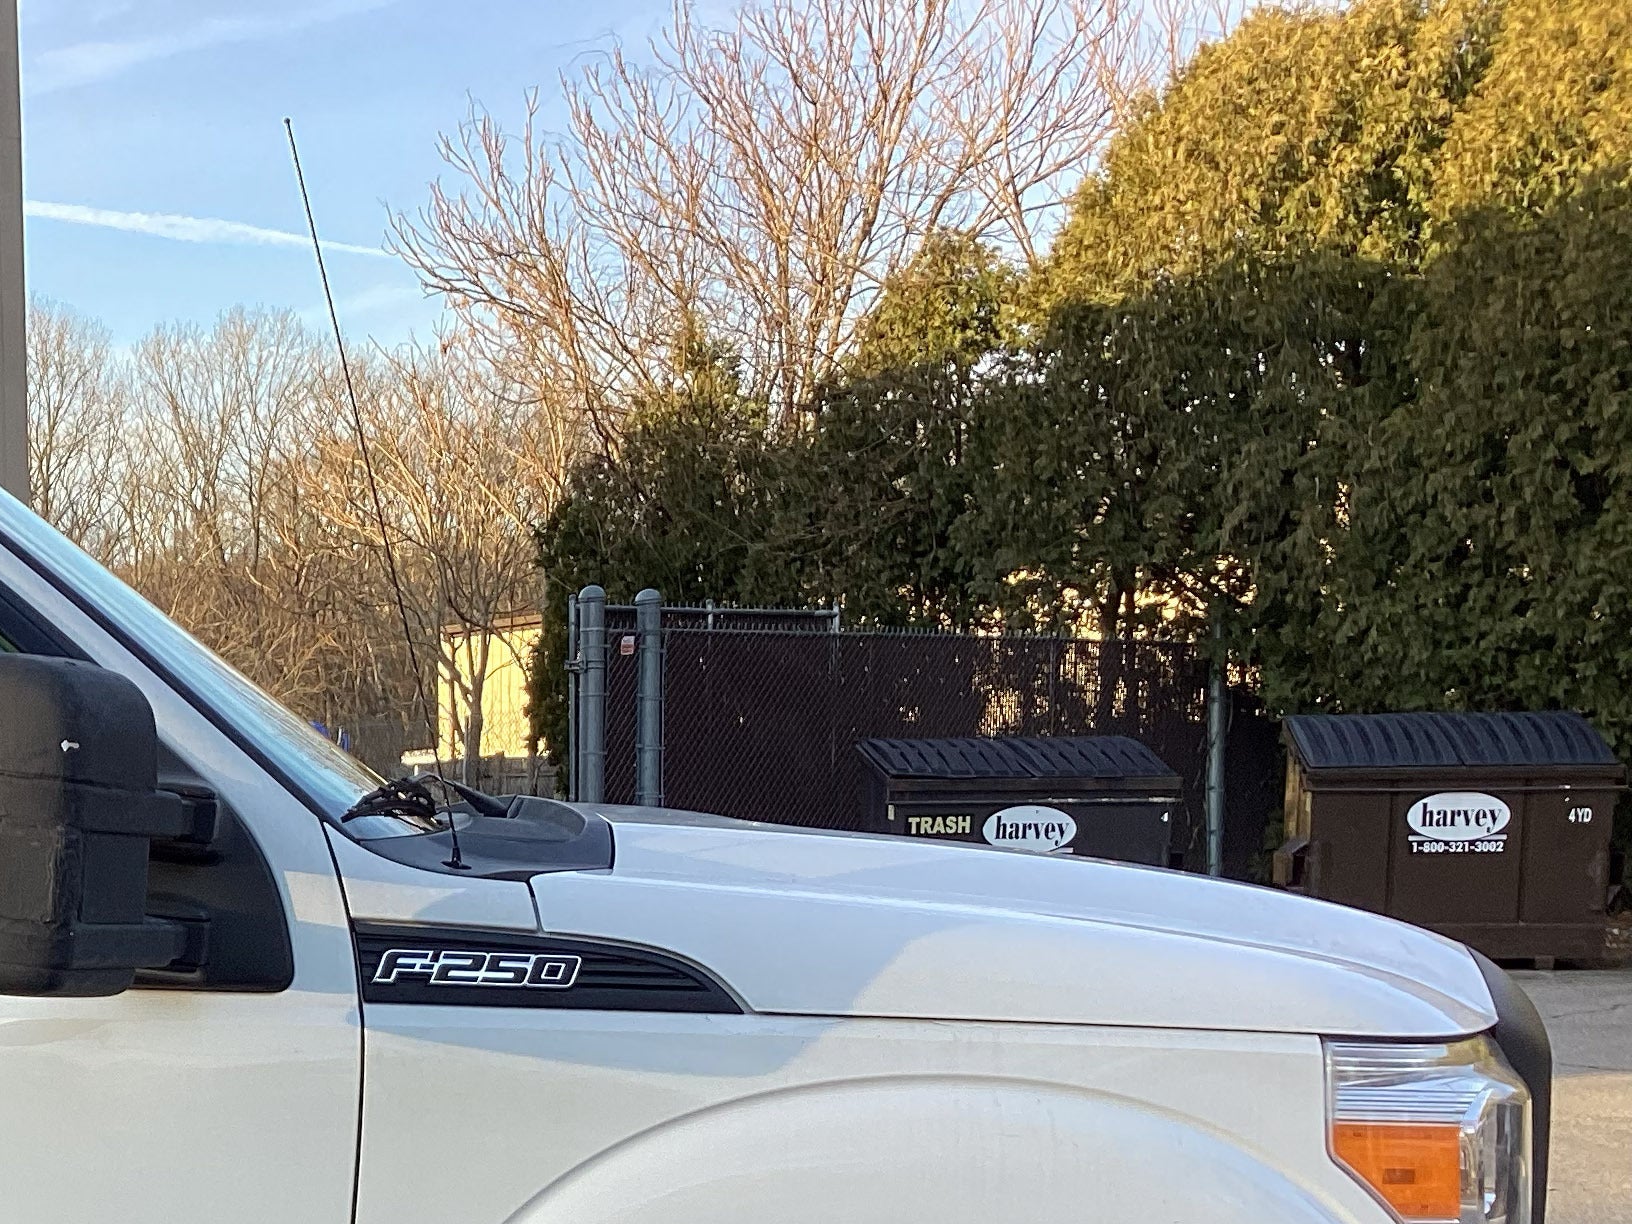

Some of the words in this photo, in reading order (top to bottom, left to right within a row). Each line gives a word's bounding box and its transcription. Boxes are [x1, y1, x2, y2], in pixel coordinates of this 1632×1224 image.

[908, 815, 971, 835] TRASH
[994, 815, 1070, 847] harvey
[1420, 802, 1502, 834] harvey
[1411, 841, 1504, 853] 1-800-321-3002
[370, 949, 582, 988] F-250
